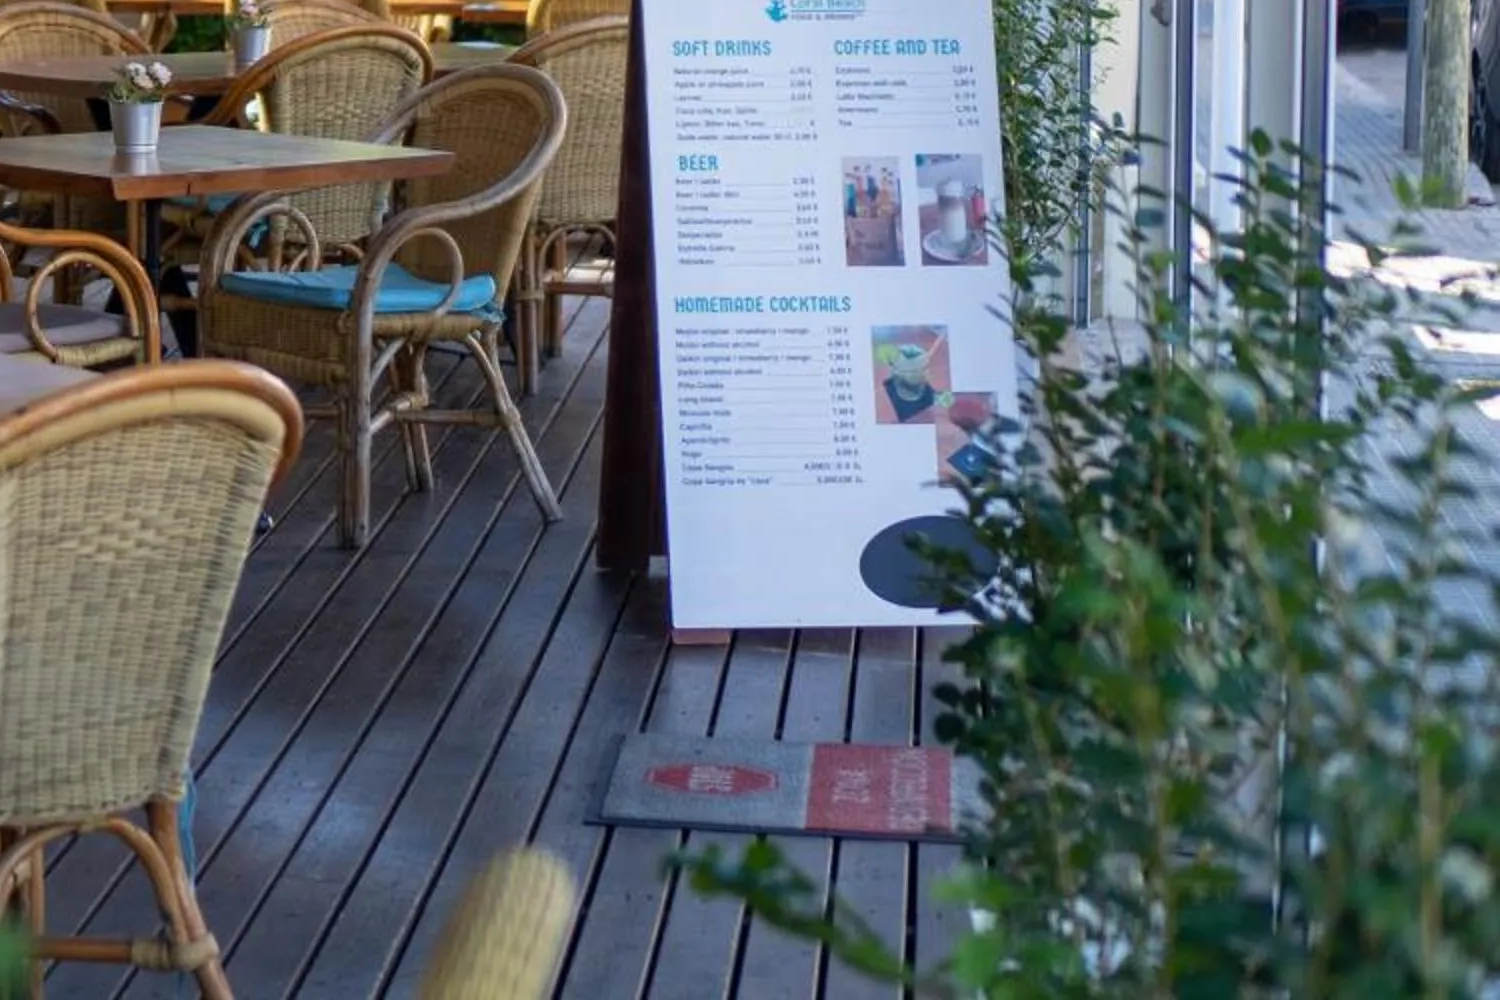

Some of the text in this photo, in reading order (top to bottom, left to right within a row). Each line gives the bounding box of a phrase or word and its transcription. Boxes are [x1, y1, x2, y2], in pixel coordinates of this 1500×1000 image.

[672, 40, 709, 57] SOFT
[833, 39, 961, 56] COFFEE AND TEA
[675, 296, 852, 313] HOMEMADE COCKTAILS
